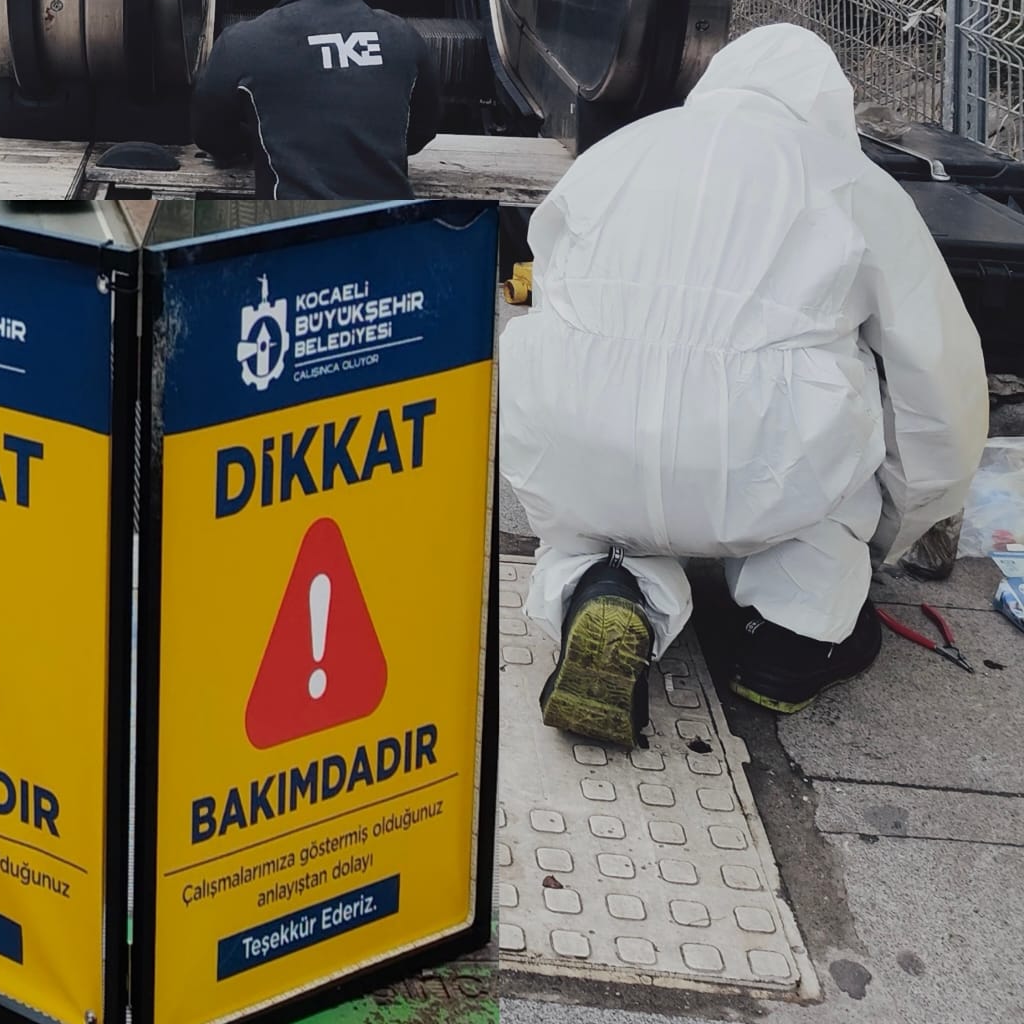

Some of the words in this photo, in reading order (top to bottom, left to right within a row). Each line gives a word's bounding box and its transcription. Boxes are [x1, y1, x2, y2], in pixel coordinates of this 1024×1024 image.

[307, 31, 383, 69] TKE
[294, 291, 424, 337] BÜYÜKŞEHİR
[295, 281, 369, 312] KOCAELİ
[294, 321, 393, 359] BELEDİYESİ
[342, 354, 380, 370] OLUYOR
[215, 398, 437, 519] DİKKAT
[191, 724, 438, 846] BAKIMDADIR
[182, 852, 295, 907] Çalışmalarımıza
[300, 825, 368, 865] göstermiş
[372, 800, 444, 838] olduğunuz
[257, 867, 328, 908] anlayıştan
[332, 852, 374, 882] dolayı
[242, 915, 317, 960] Teşekkür
[321, 894, 378, 931] Ederiz.
